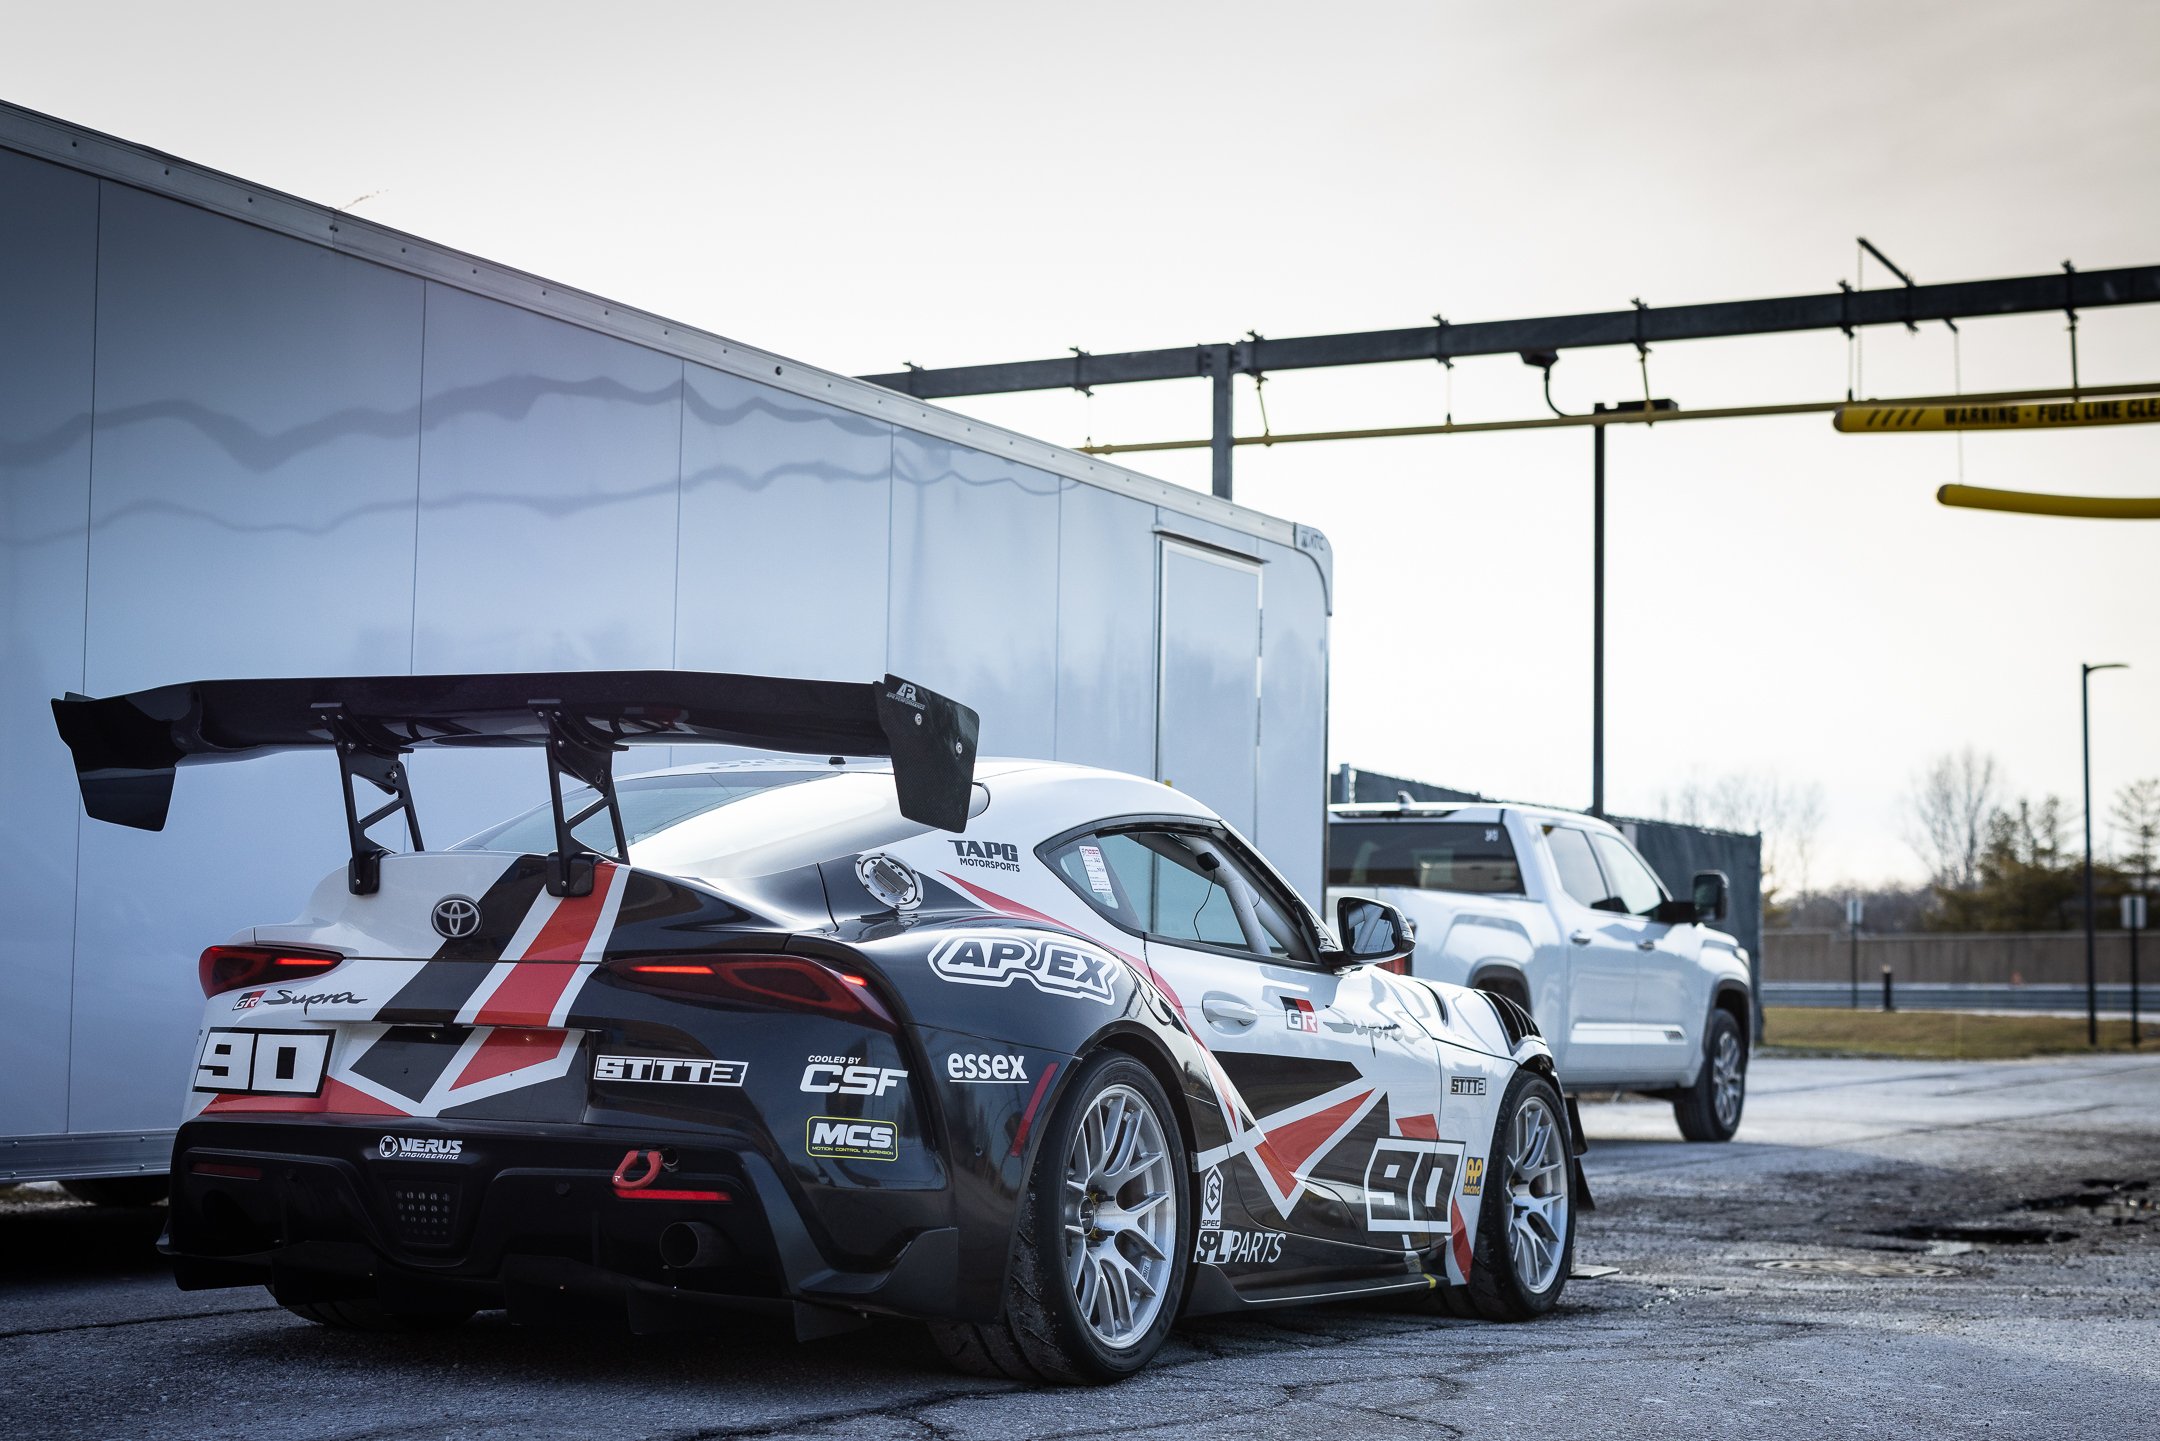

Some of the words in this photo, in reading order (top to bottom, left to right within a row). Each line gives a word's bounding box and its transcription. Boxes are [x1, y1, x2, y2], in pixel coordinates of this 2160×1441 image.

[1944, 405, 2019, 424] WARNING
[2037, 402, 2078, 423] FUEL
[2084, 401, 2120, 421] LINE
[2127, 398, 2160, 419] CLE
[947, 840, 1018, 862] TAPG
[960, 858, 1020, 872] MOTORSPORTS
[947, 940, 1107, 990] APEX
[263, 989, 368, 1016] Supra
[1285, 1008, 1317, 1033] GR
[195, 1031, 331, 1094] 90
[808, 1055, 846, 1063] COOLED
[848, 1056, 861, 1064] BY
[947, 1052, 1028, 1080] essex
[800, 1063, 908, 1096] CSF
[399, 1137, 463, 1154] VERUS
[812, 1122, 893, 1149] MCS
[399, 1151, 459, 1160] ENGINEERING
[1465, 1158, 1483, 1184] AP
[1367, 1149, 1460, 1223] 90
[1464, 1185, 1481, 1195] RACING
[1202, 1219, 1219, 1227] SPEC
[1226, 1230, 1287, 1263] PARTS
